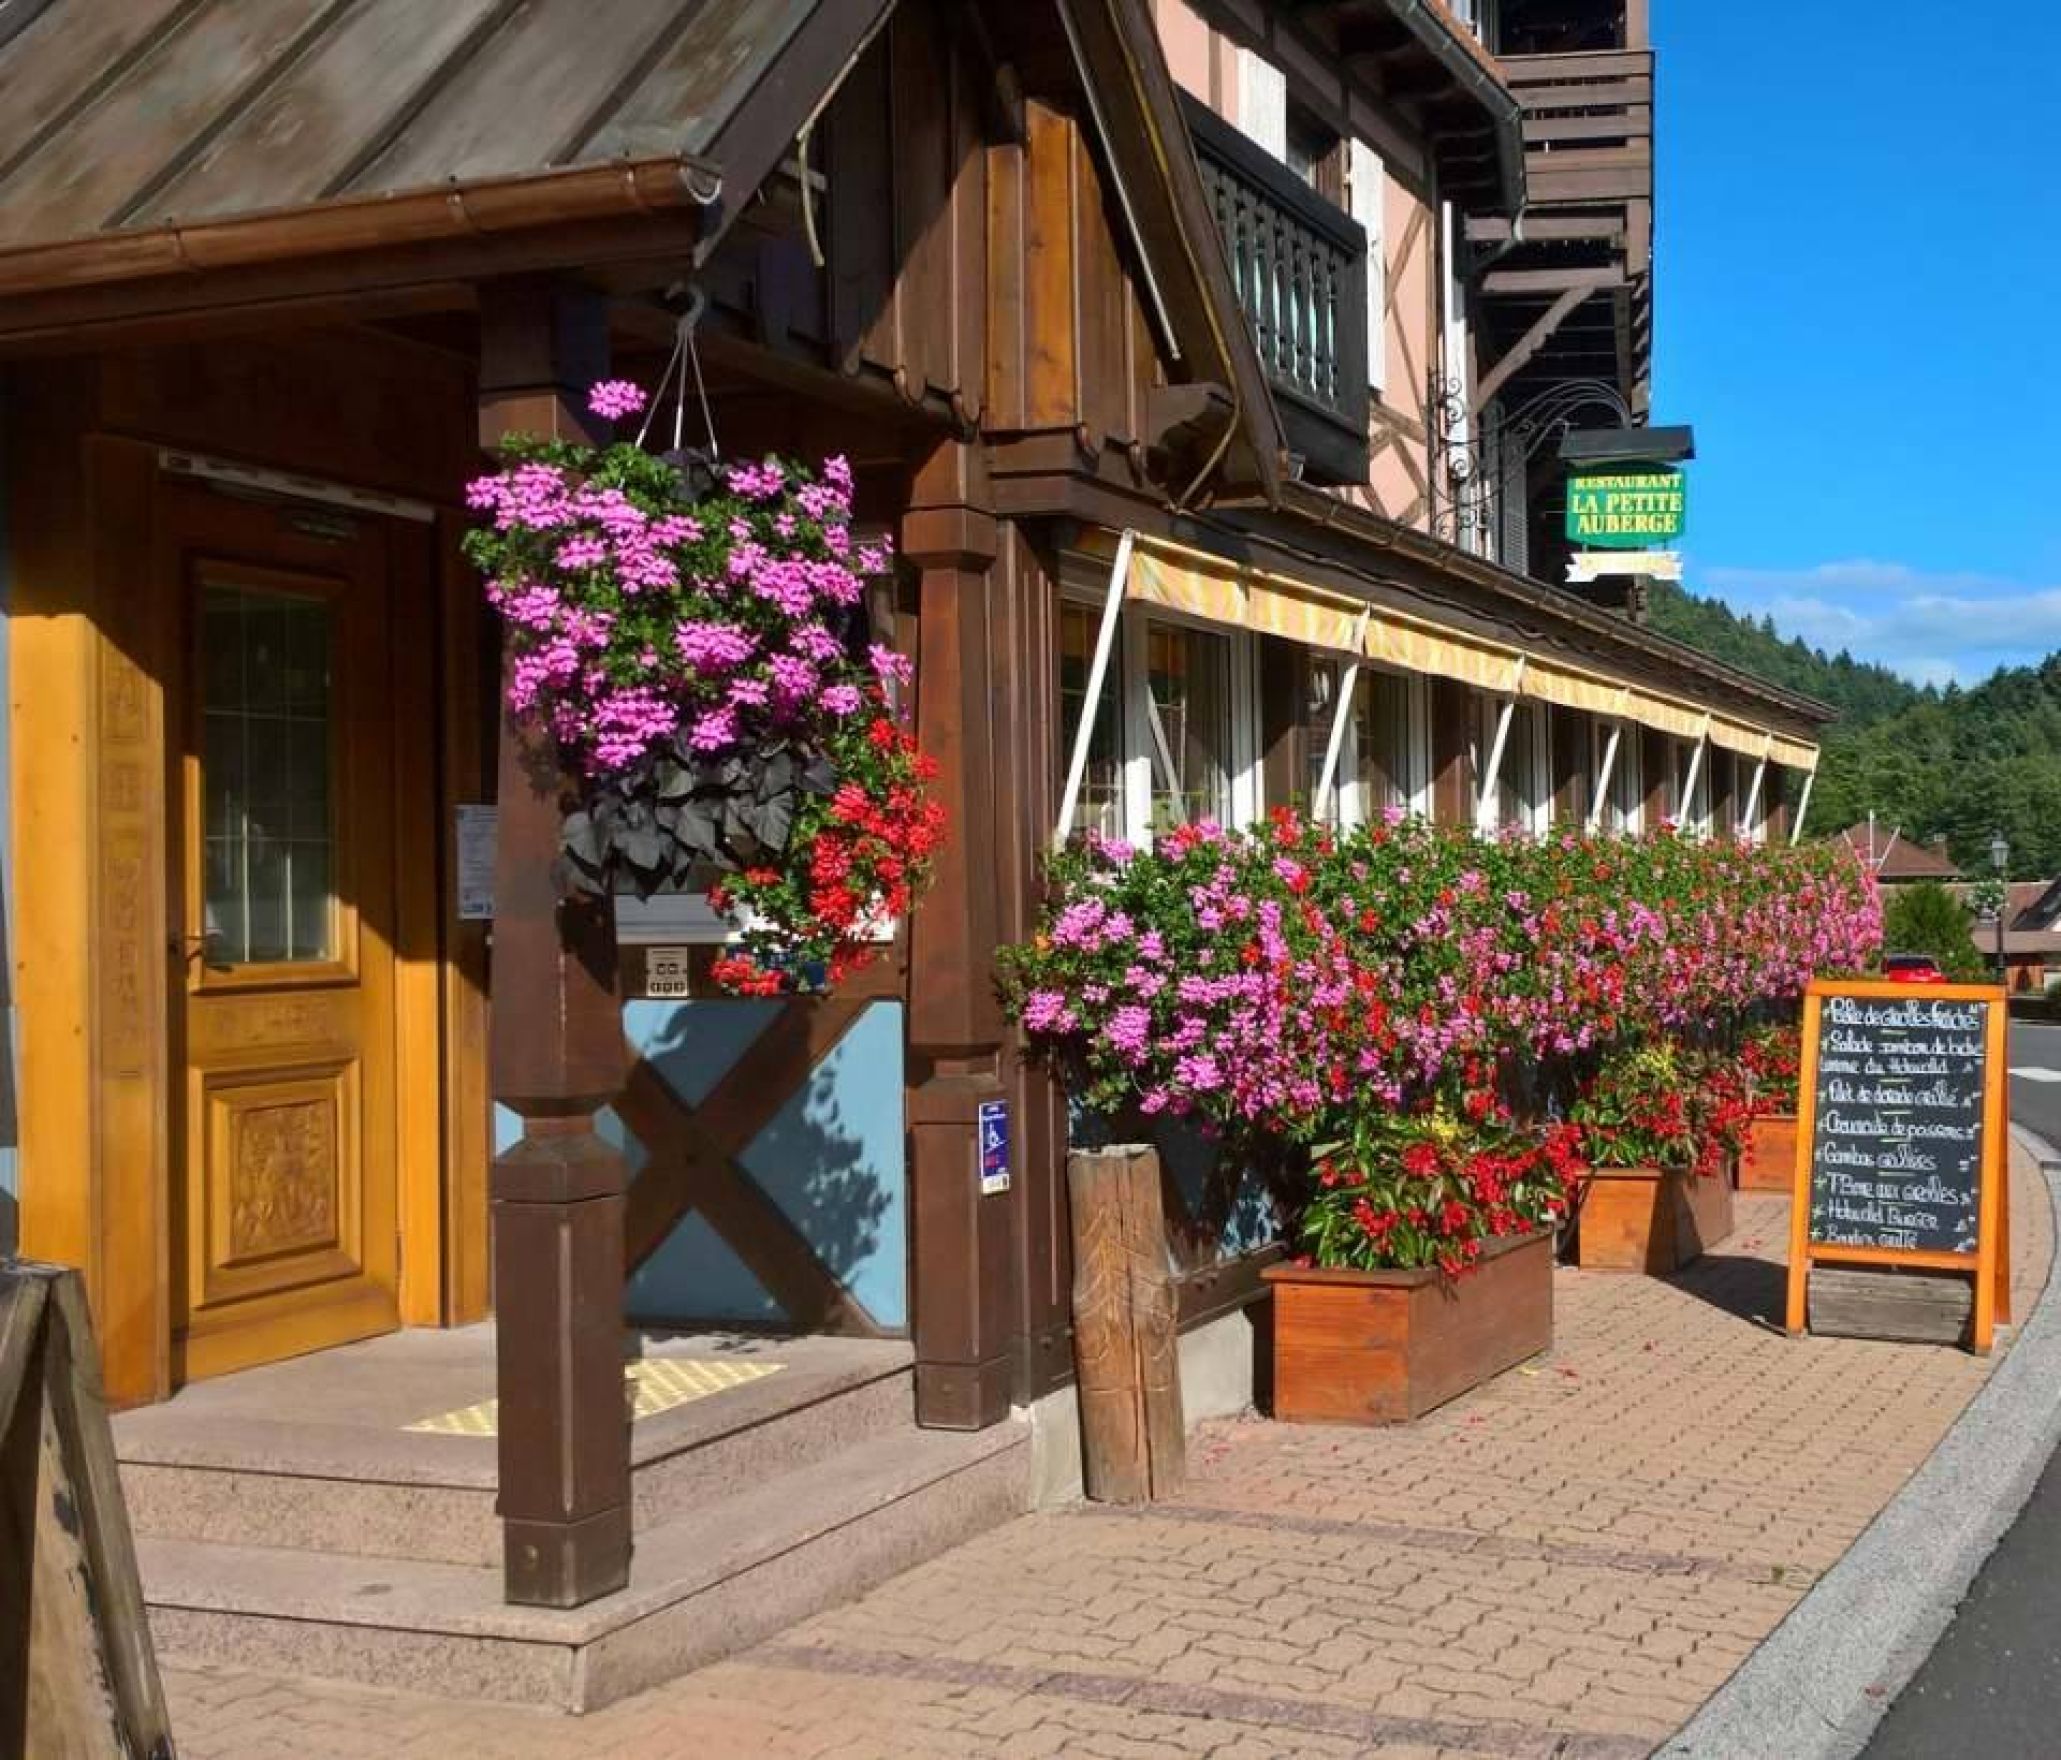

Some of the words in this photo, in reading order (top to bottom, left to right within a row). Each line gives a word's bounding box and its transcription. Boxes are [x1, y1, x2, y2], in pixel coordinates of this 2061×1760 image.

[1575, 474, 1682, 489] RESTAURANT
[1572, 495, 1598, 513] LA
[1606, 493, 1683, 512] PETITE
[1577, 514, 1678, 534] AUBERGE
[1891, 1116, 1907, 1136] de
